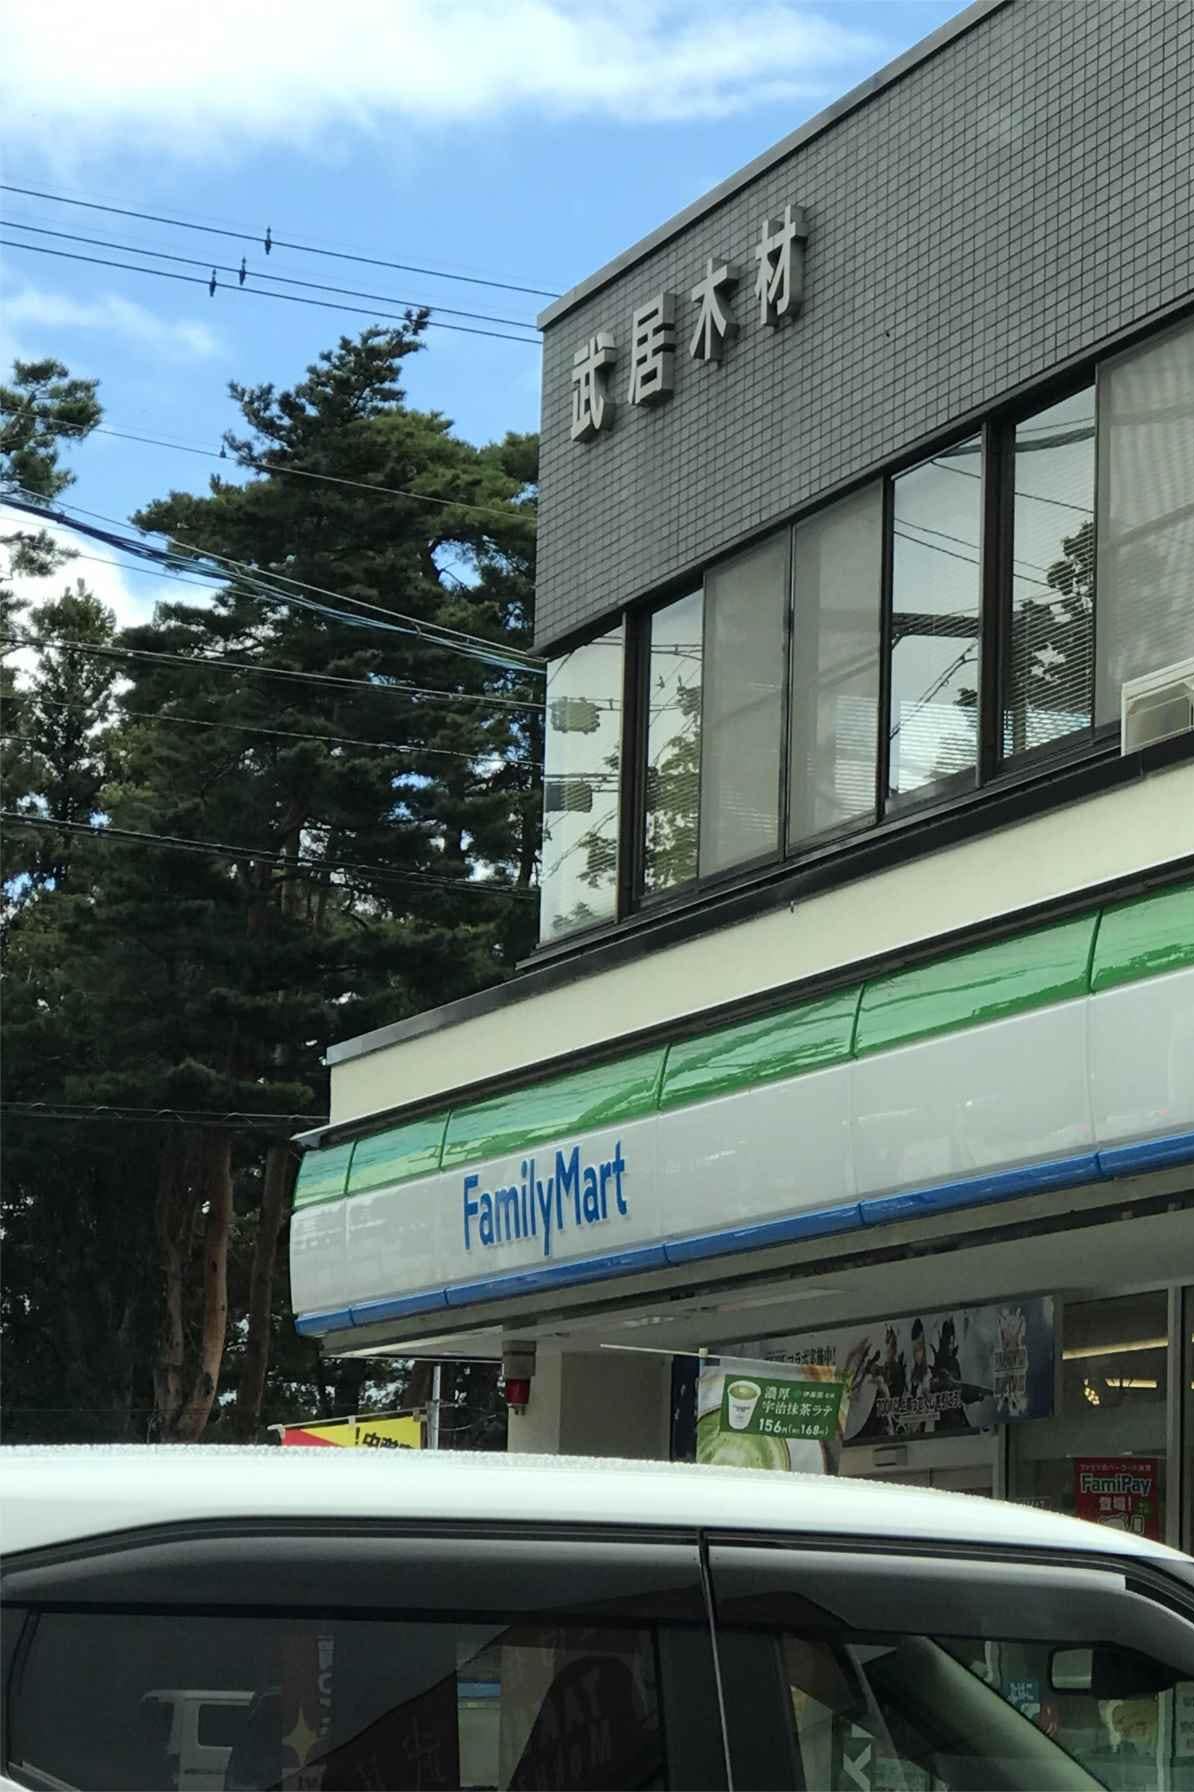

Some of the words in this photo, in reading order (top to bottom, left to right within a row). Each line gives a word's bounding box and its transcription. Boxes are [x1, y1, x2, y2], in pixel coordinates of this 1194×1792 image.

[570, 203, 806, 442] 武居木材
[463, 1140, 628, 1257] FamilyMart
[763, 1385, 791, 1400] 濃厚
[761, 1401, 834, 1417] 宇治抹茶ラテ
[1080, 1473, 1152, 1496] FamiPay
